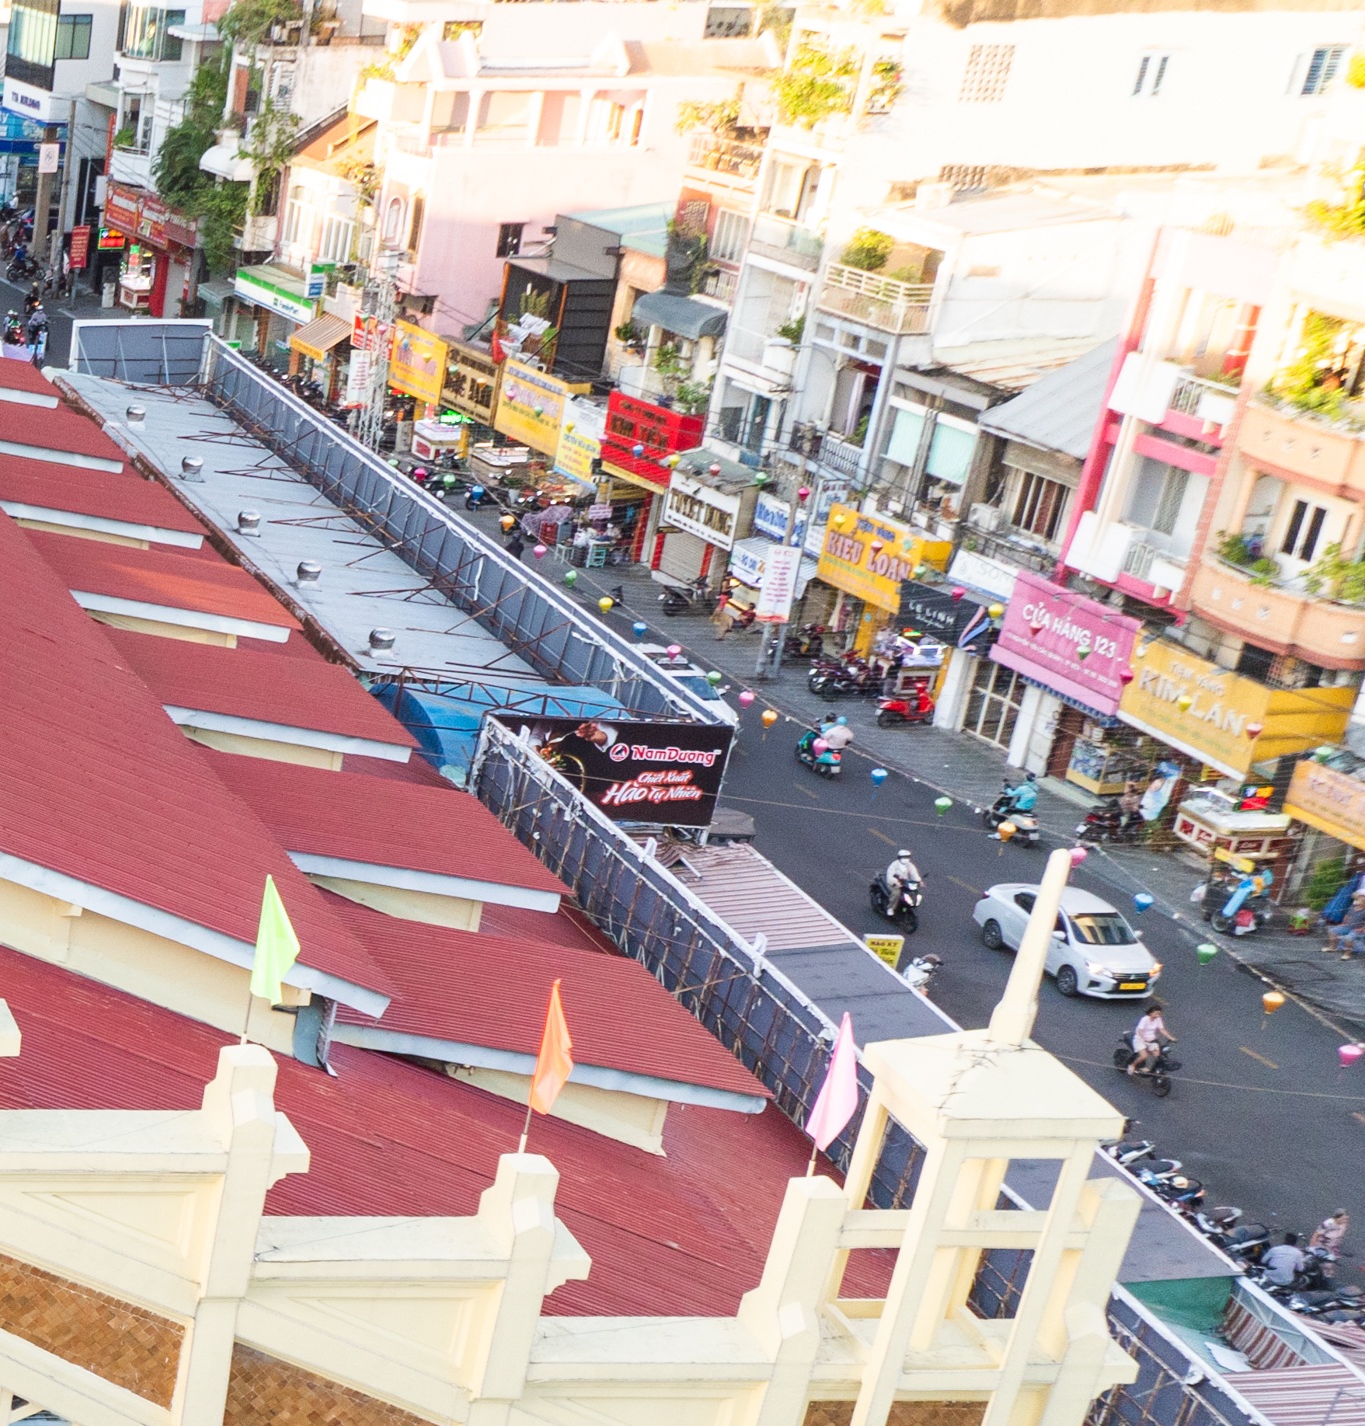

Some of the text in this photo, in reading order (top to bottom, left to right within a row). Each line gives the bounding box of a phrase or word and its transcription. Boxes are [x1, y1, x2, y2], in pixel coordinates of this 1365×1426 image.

[866, 547, 912, 582] LOAN
[1052, 616, 1092, 647] HÀNG
[1094, 635, 1117, 659] 123
[1139, 666, 1188, 703] KIM
[603, 783, 647, 804] Hào
